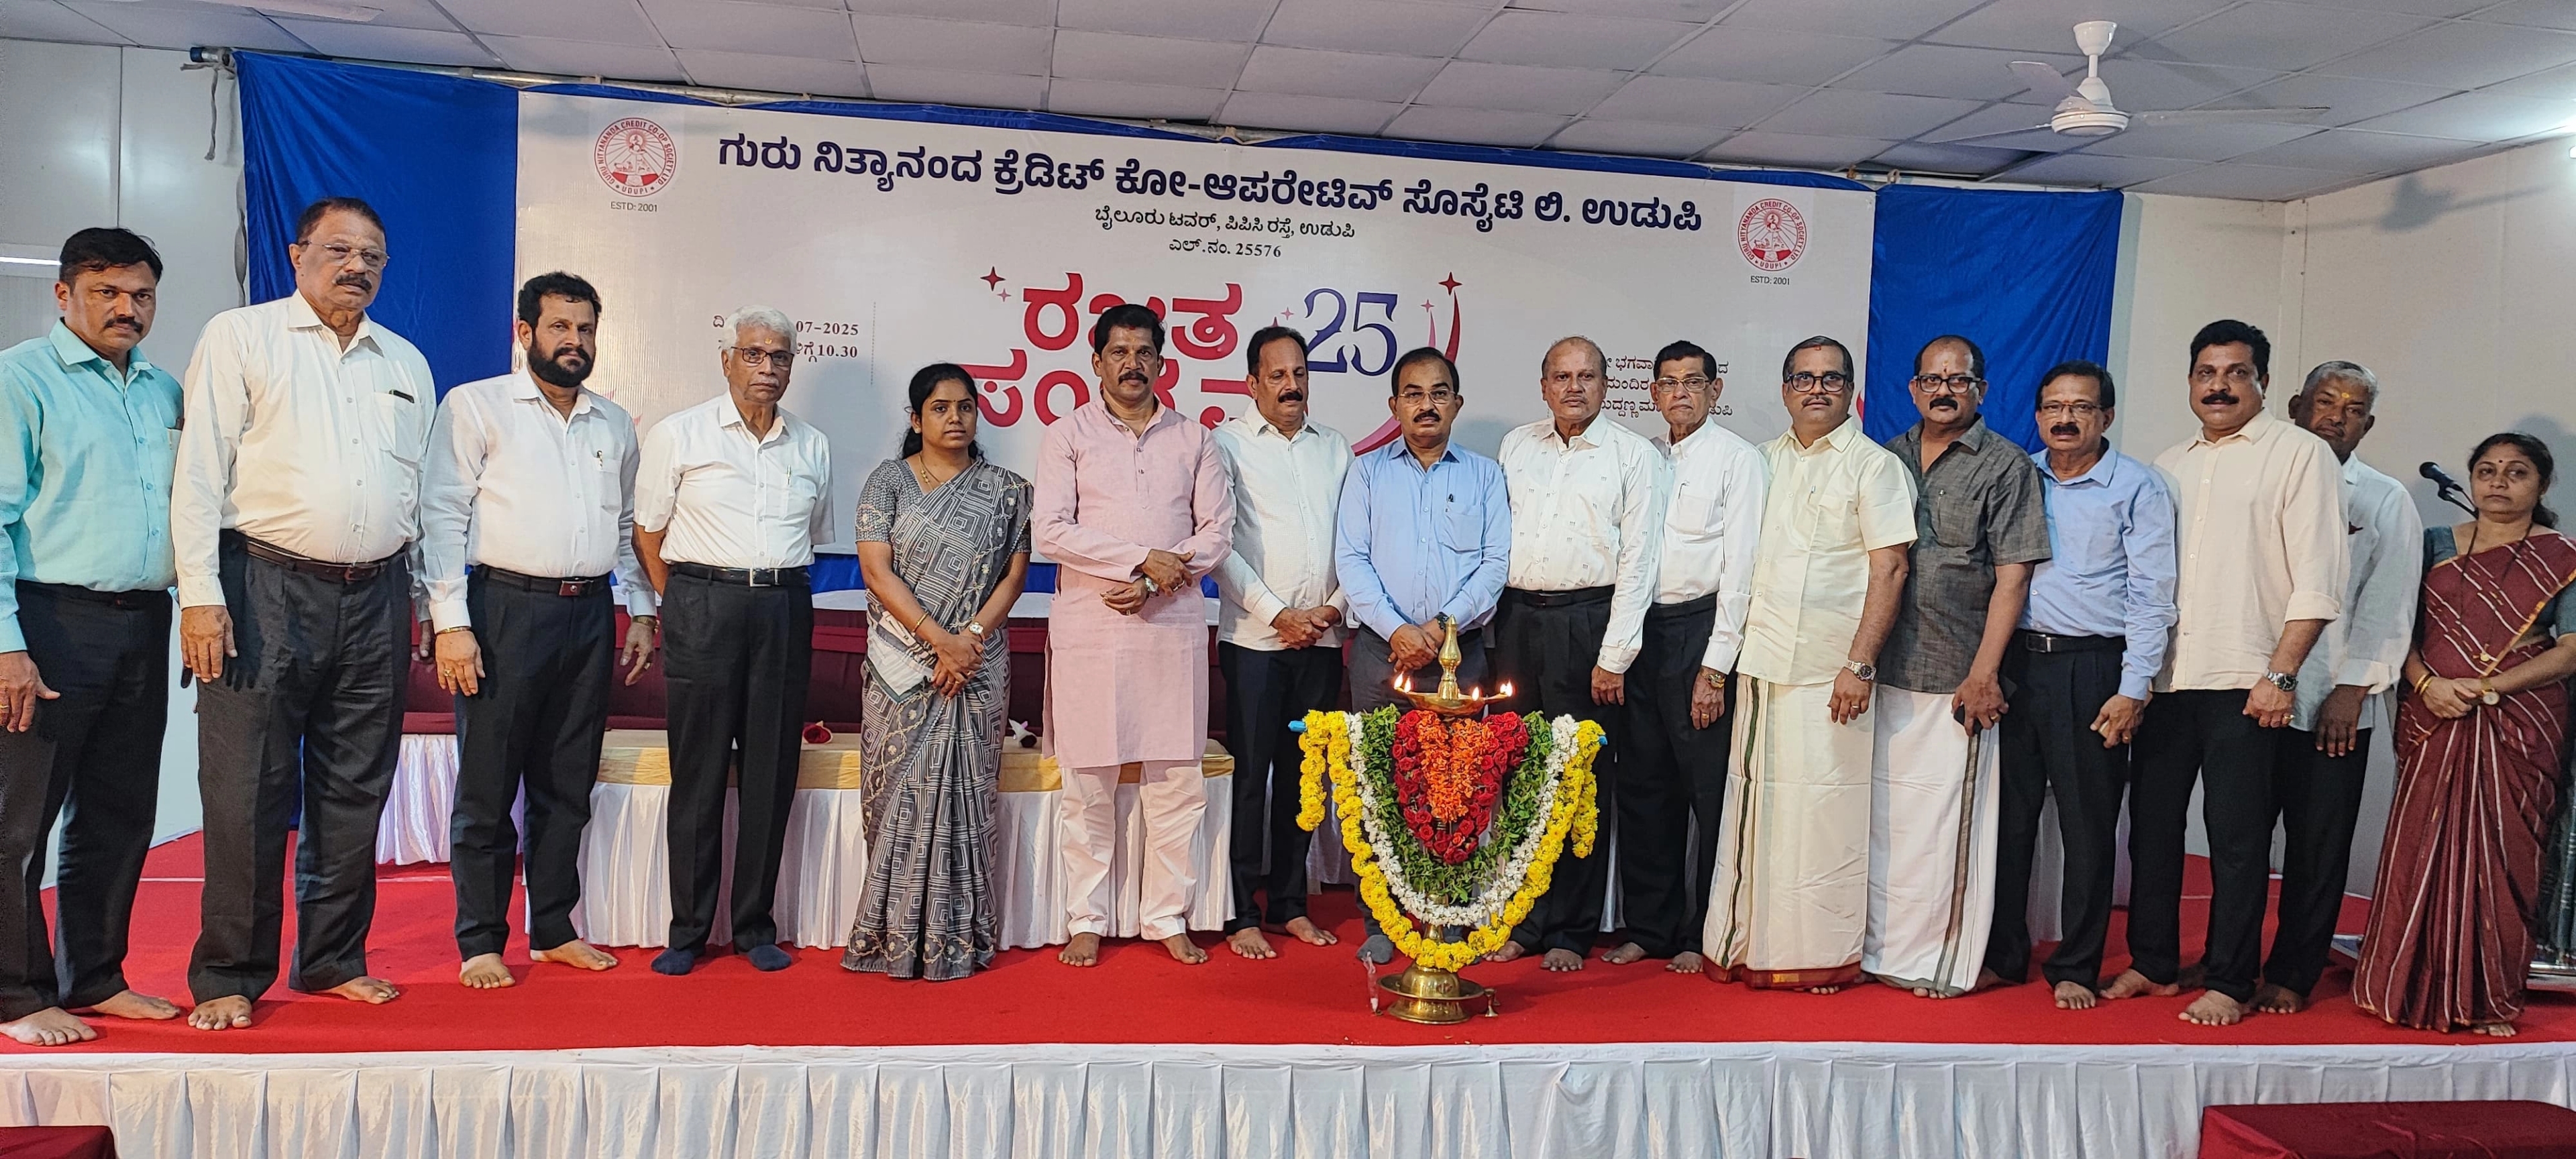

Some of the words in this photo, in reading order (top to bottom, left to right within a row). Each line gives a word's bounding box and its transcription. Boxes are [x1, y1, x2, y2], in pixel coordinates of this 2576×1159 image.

[621, 120, 647, 129] CREDIT
[648, 124, 668, 142] CO-OP
[597, 125, 621, 164] NITYANANDA
[664, 143, 674, 176] SOCIETY
[599, 167, 615, 184] GURU
[719, 133, 801, 169] ಗುರು
[814, 141, 982, 191] ನಿತ್ಯಾನಂದ
[994, 149, 1104, 195] ಕ್ರೆಡಿಟ್
[1115, 158, 1393, 211] ಕೋ-ಆಪರೇಟಿವ್
[1403, 178, 1523, 232] ಸೊಸೈಟಿ
[1535, 191, 1570, 222] ಲಿ.
[1582, 197, 1702, 231] ಉಡುಪಿ
[621, 186, 648, 195] UDUPI
[610, 201, 637, 211] ESTD:
[637, 203, 658, 213] 2001
[1095, 205, 1165, 230] ಬೈಲೂರು
[1169, 212, 1220, 231] ಟವರ್,
[1225, 215, 1264, 232] ಪಿಪಿಸಿ
[1267, 217, 1295, 239] ರಸ್ತೆ,
[1299, 221, 1355, 237] ಉಡುಪಿ
[1760, 201, 1782, 209] CREDIT
[1783, 204, 1800, 221] CO-OP
[1796, 221, 1805, 250] SOCIETY
[1235, 243, 1281, 258] 25576
[1760, 261, 1782, 269] UDUPI
[1750, 275, 1772, 284] ESTD:
[1773, 276, 1790, 286] 2001
[1303, 288, 1398, 376] 25
